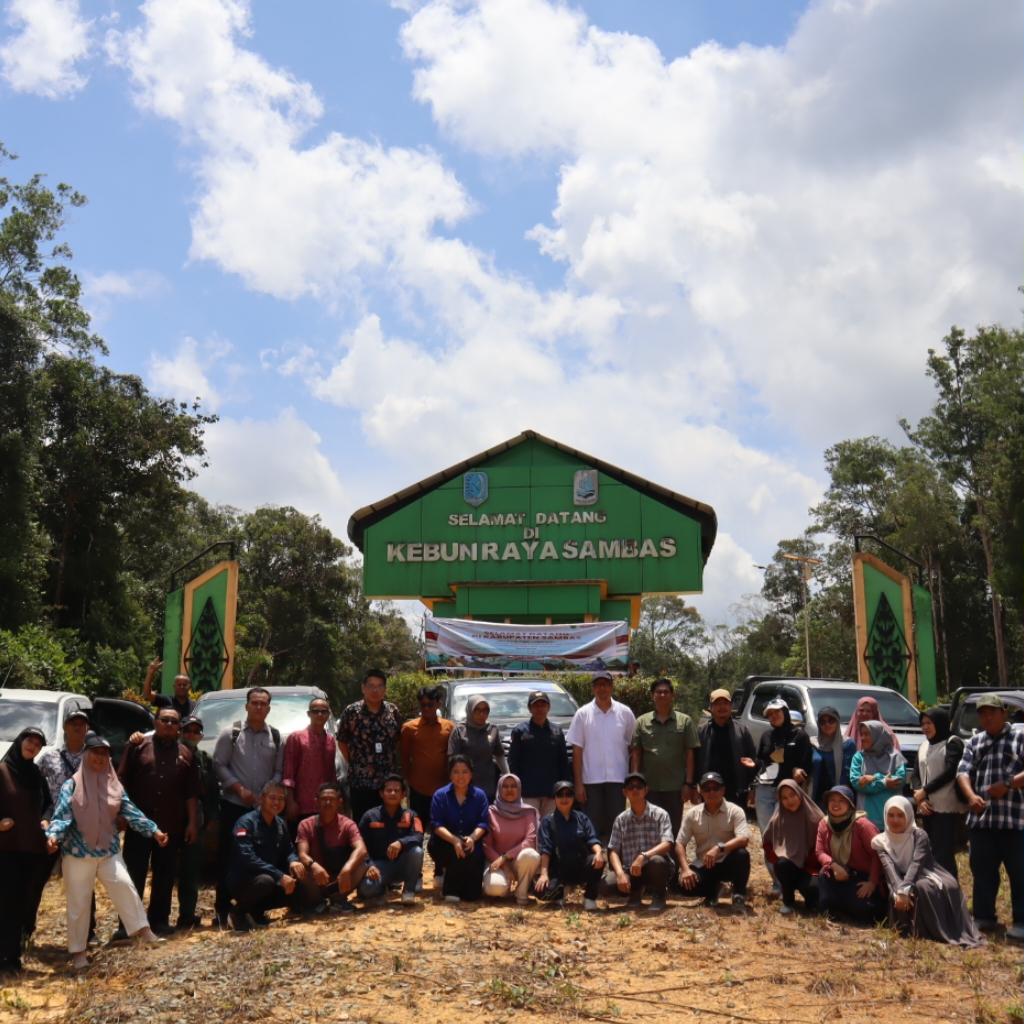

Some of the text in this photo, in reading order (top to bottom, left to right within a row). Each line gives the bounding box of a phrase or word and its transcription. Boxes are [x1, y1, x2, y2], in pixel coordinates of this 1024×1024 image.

[448, 511, 606, 527] SELAMAT DATANG
[523, 527, 540, 540] DI
[387, 537, 677, 562] KEBUN RAYA SAMBAS
